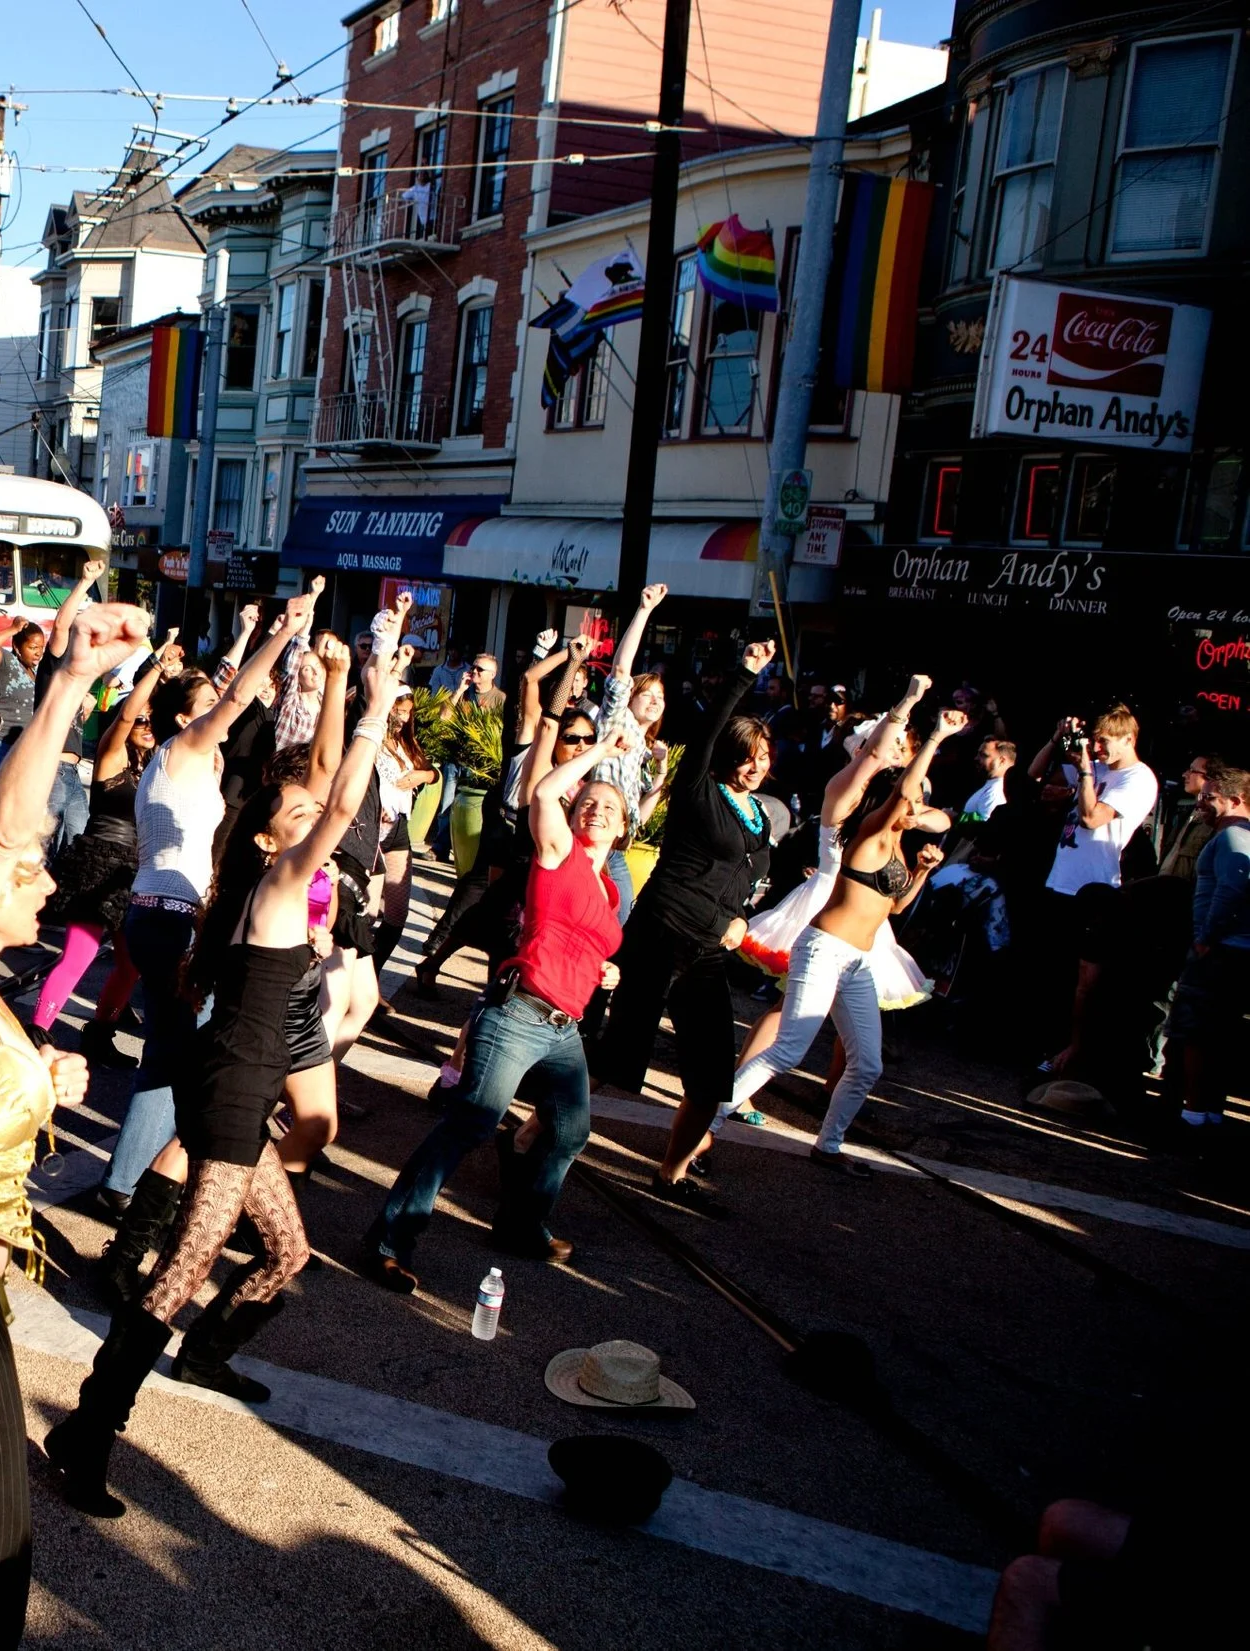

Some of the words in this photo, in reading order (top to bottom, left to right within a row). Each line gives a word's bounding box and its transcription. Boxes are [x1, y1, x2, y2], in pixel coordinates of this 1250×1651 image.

[1010, 330, 1050, 363] 24
[1011, 368, 1042, 379] HOURS
[1005, 385, 1094, 433] Orphan
[1100, 396, 1190, 448] Andy's
[784, 502, 802, 516] 40
[325, 510, 362, 533] SUN
[363, 511, 444, 537] TANNING
[812, 519, 842, 531] STOPPING
[808, 531, 828, 542] ANY
[806, 544, 827, 554] TIME
[337, 553, 358, 569] AQUA
[362, 554, 402, 571] MASSAGE
[893, 546, 970, 589] Orphan
[987, 551, 1106, 599] Andy's
[888, 585, 937, 601] BREAKFAST
[967, 592, 1009, 607] LUNCH
[1049, 597, 1108, 615] DINNER
[1167, 606, 1202, 622] Open
[1206, 610, 1228, 621] 24
